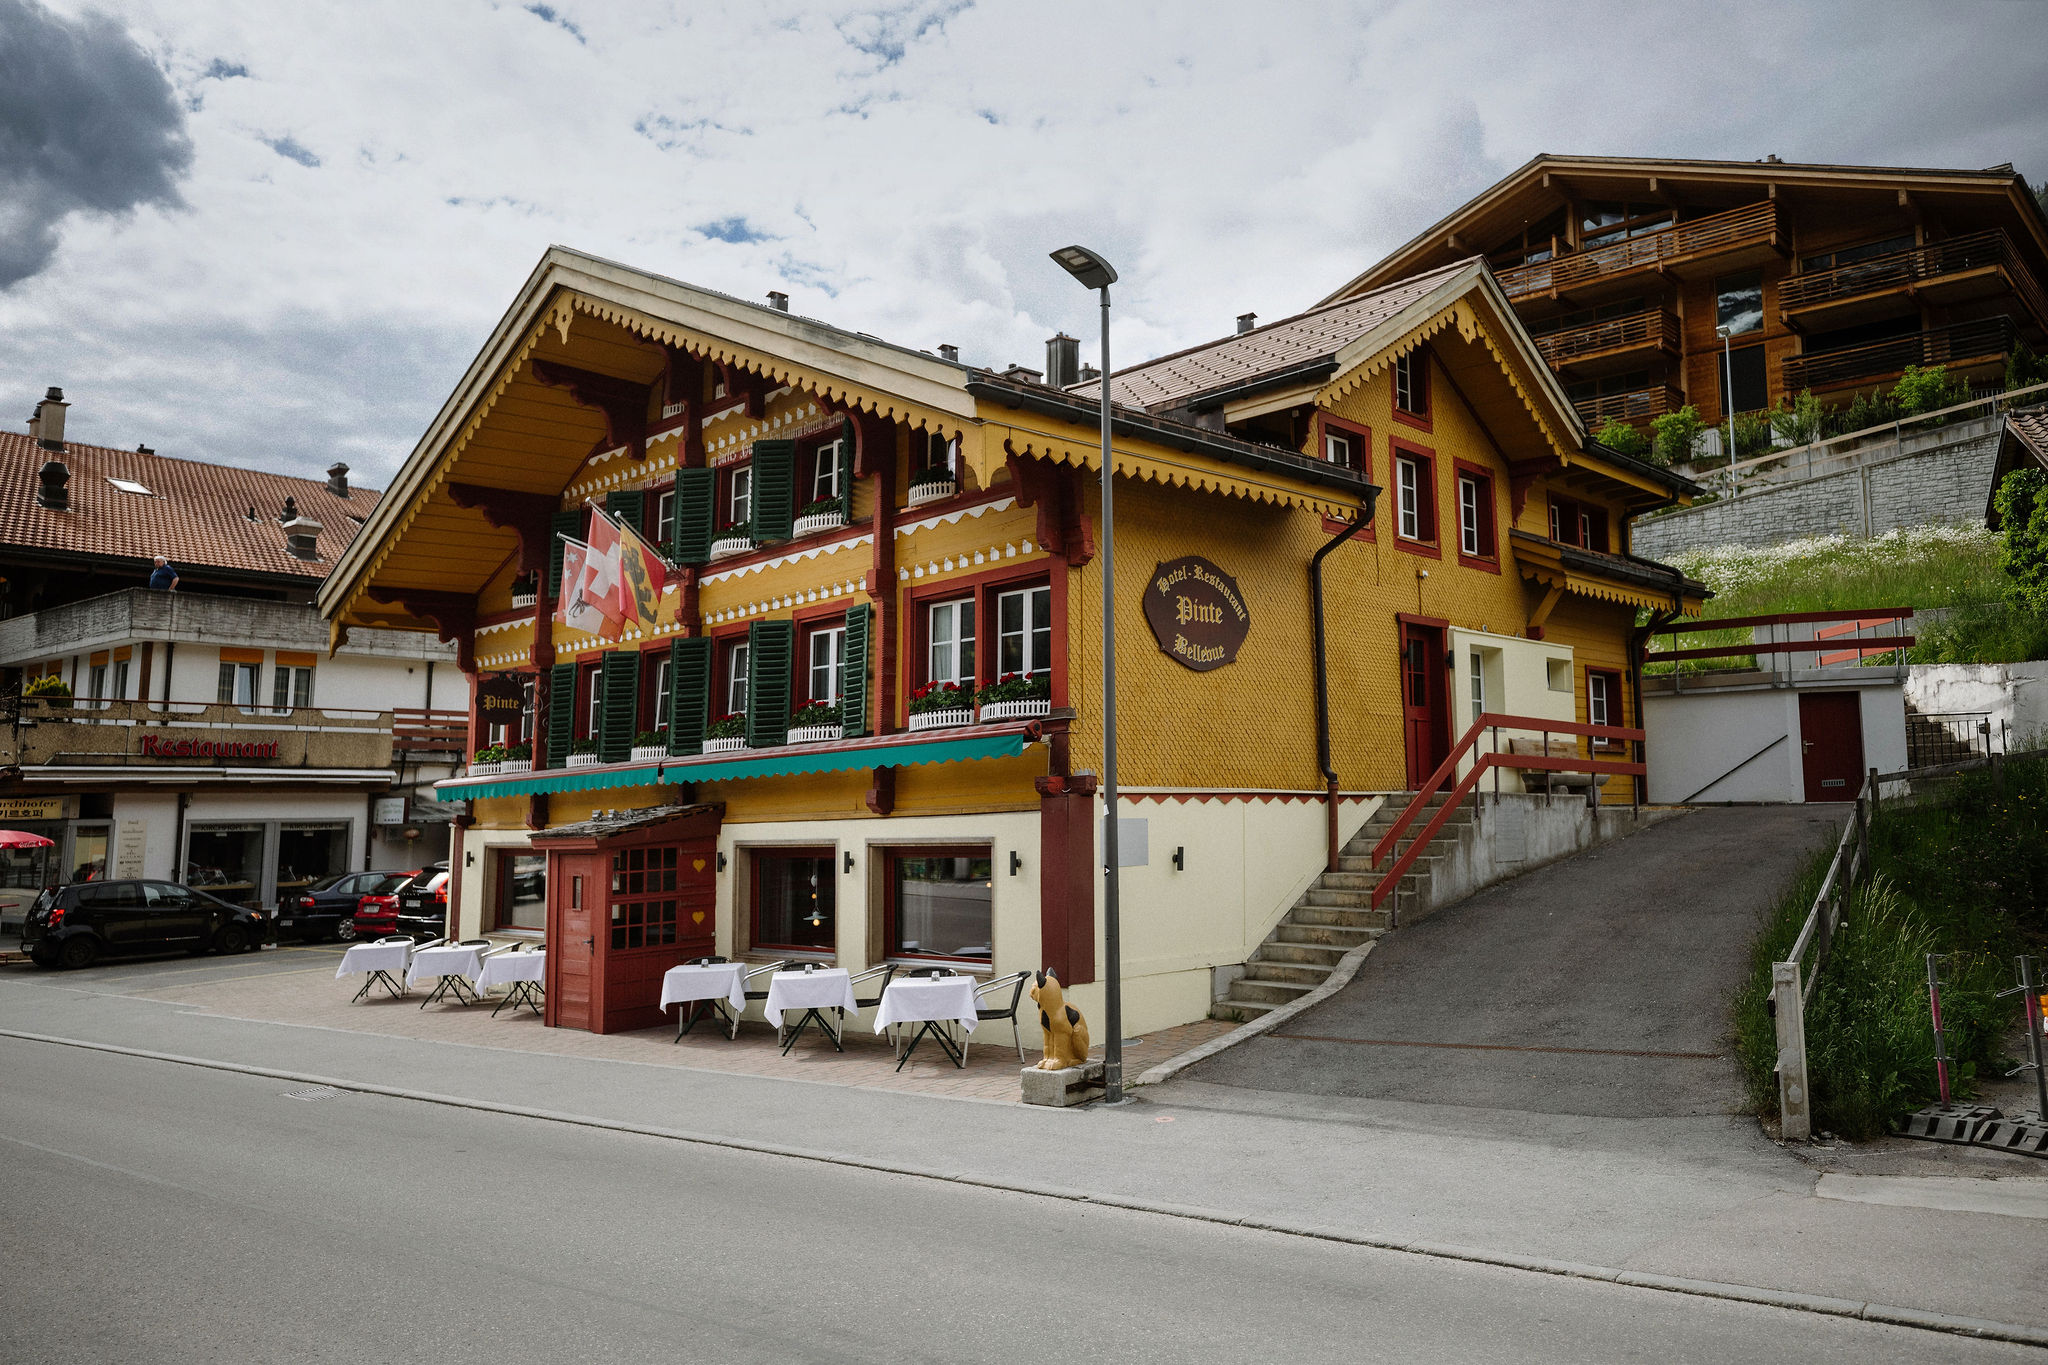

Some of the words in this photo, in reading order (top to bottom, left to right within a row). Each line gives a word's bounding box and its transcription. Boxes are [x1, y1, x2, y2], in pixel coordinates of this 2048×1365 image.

[1175, 595, 1224, 625] Pinte
[1173, 633, 1226, 663] Bellevue
[483, 694, 519, 711] Pinte
[141, 734, 279, 758] Restaurant
